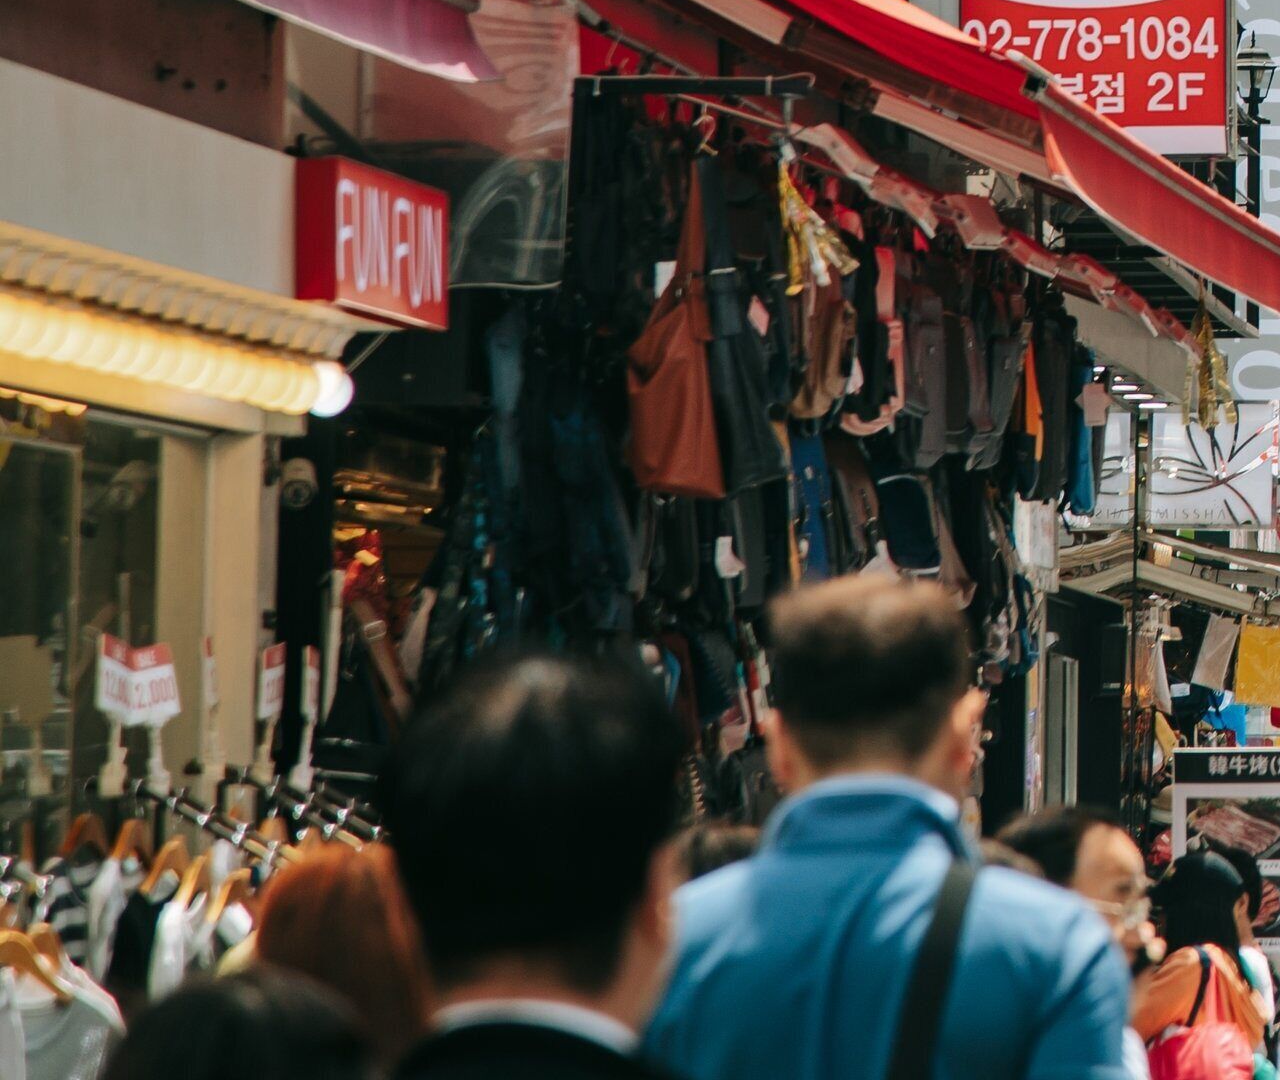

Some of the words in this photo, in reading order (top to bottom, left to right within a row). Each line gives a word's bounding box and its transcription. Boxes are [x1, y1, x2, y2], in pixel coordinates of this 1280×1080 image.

[962, 15, 1219, 61] 02-778-1084
[1146, 73, 1206, 112] 2F
[336, 179, 390, 291] FUN
[393, 197, 442, 308] FUN
